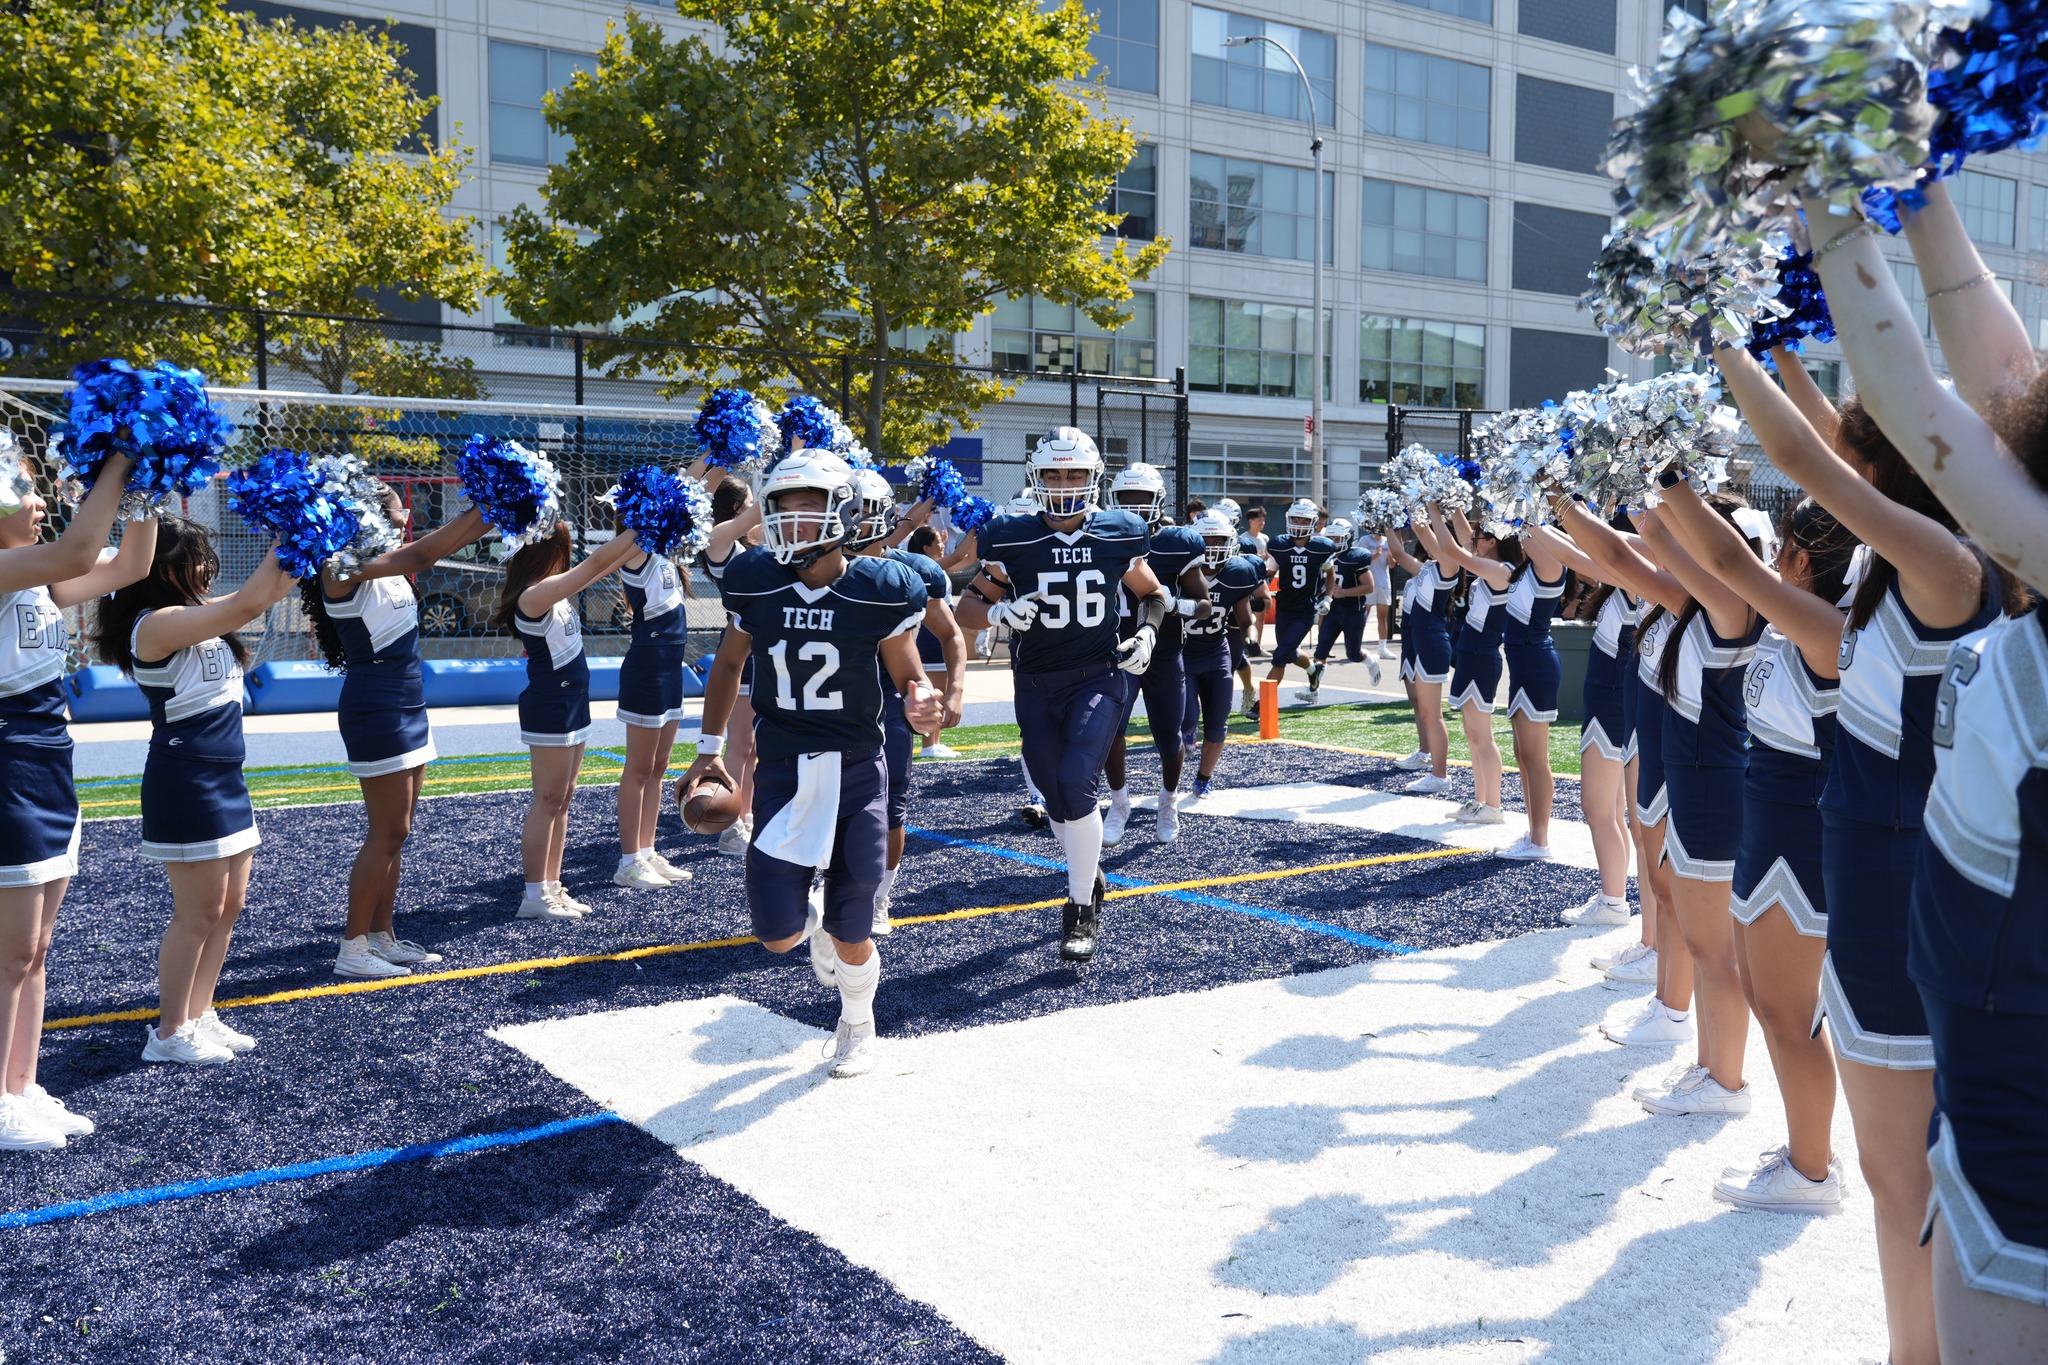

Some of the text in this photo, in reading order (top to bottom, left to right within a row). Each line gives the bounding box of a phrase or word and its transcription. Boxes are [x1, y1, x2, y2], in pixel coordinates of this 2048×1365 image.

[1052, 547, 1093, 564] TECH
[1290, 555, 1308, 564] TECH
[1292, 565, 1307, 589] 9
[1037, 569, 1106, 629] 56
[782, 606, 834, 631] TECH
[767, 639, 844, 711] 12
